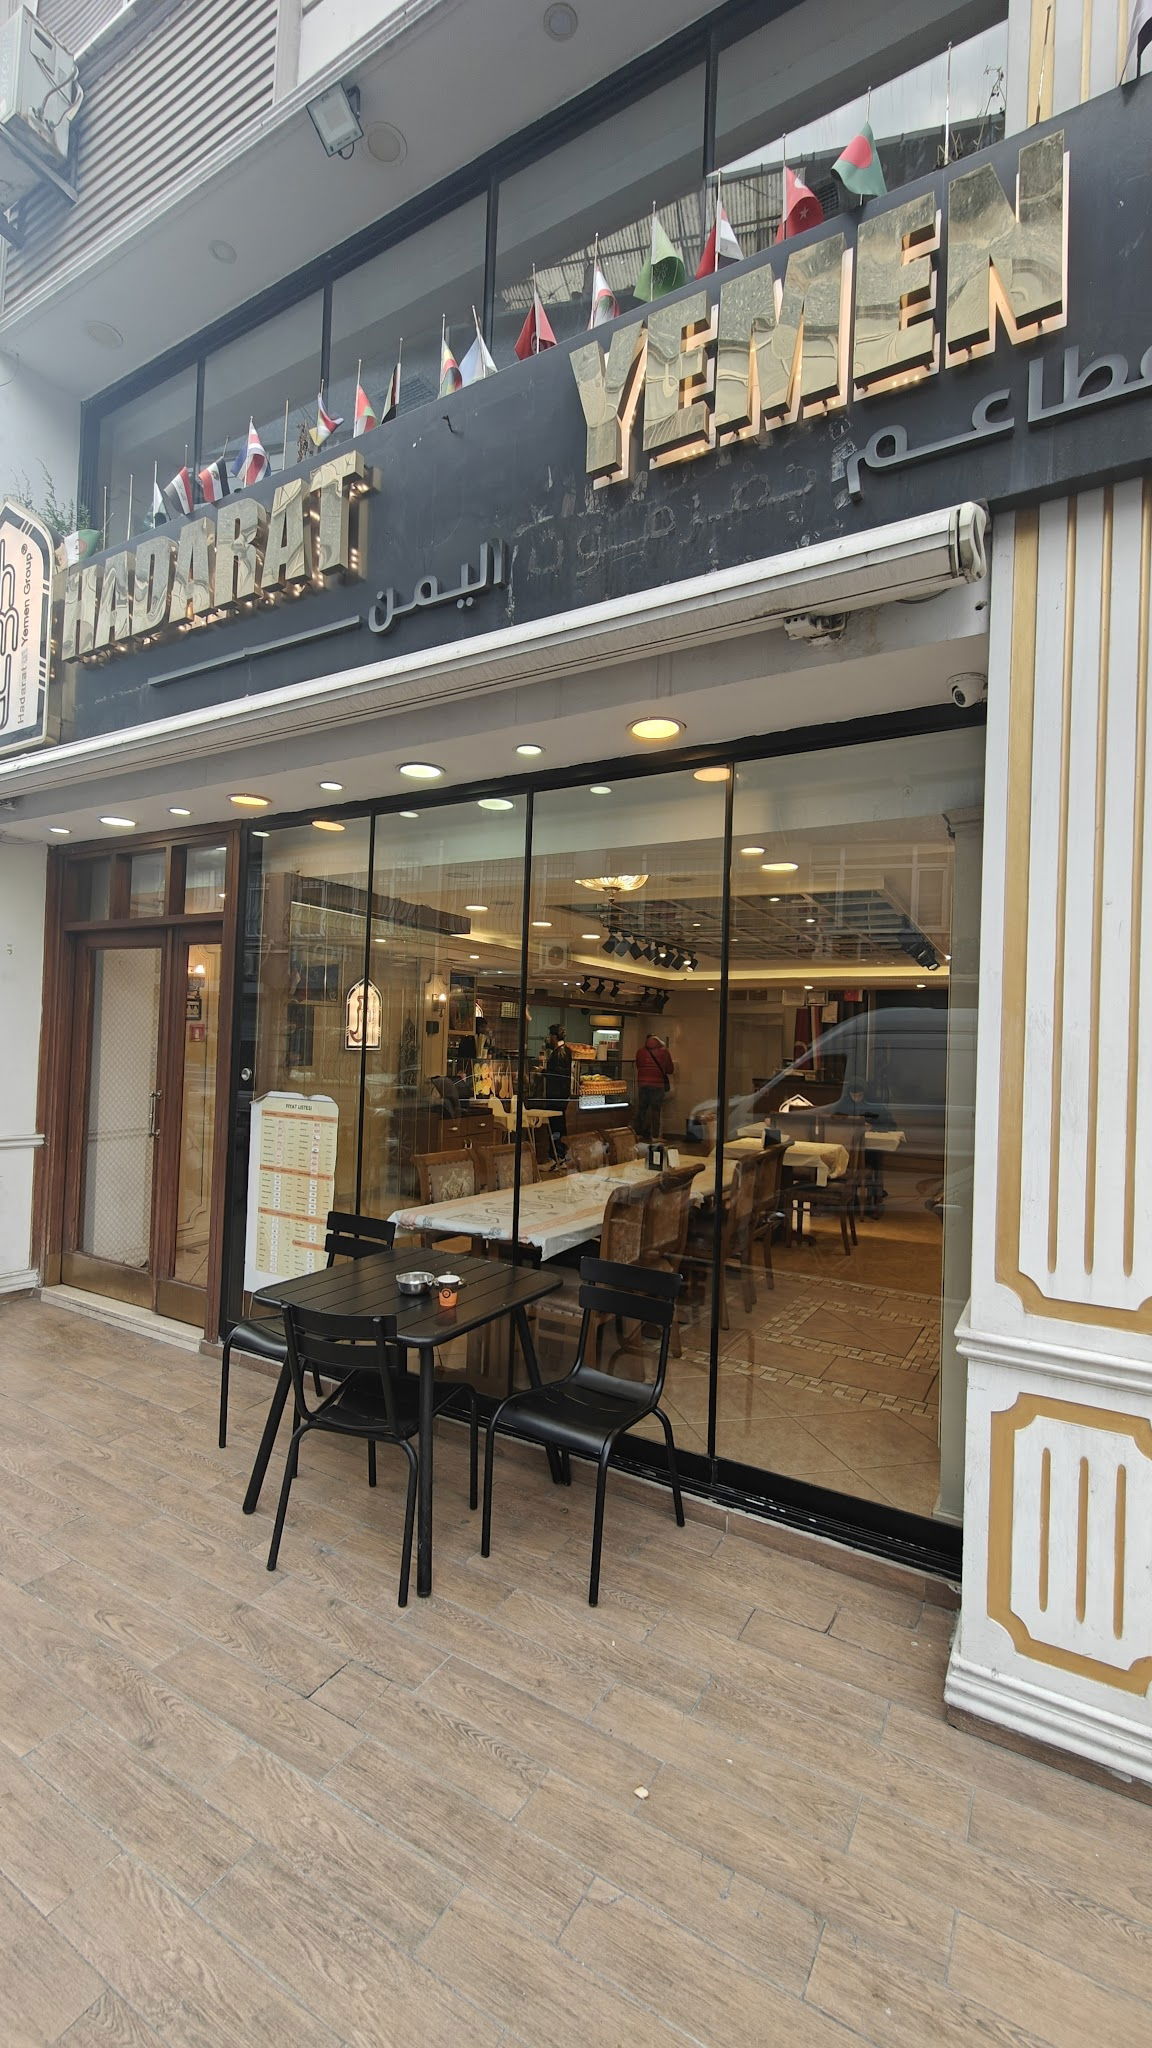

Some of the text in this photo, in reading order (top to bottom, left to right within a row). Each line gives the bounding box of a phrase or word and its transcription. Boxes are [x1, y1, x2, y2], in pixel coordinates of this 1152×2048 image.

[62, 450, 364, 662] HADARAT
[570, 129, 1068, 487] YEMEN
[21, 598, 31, 647] Yemen
[368, 538, 506, 633] اليمن
